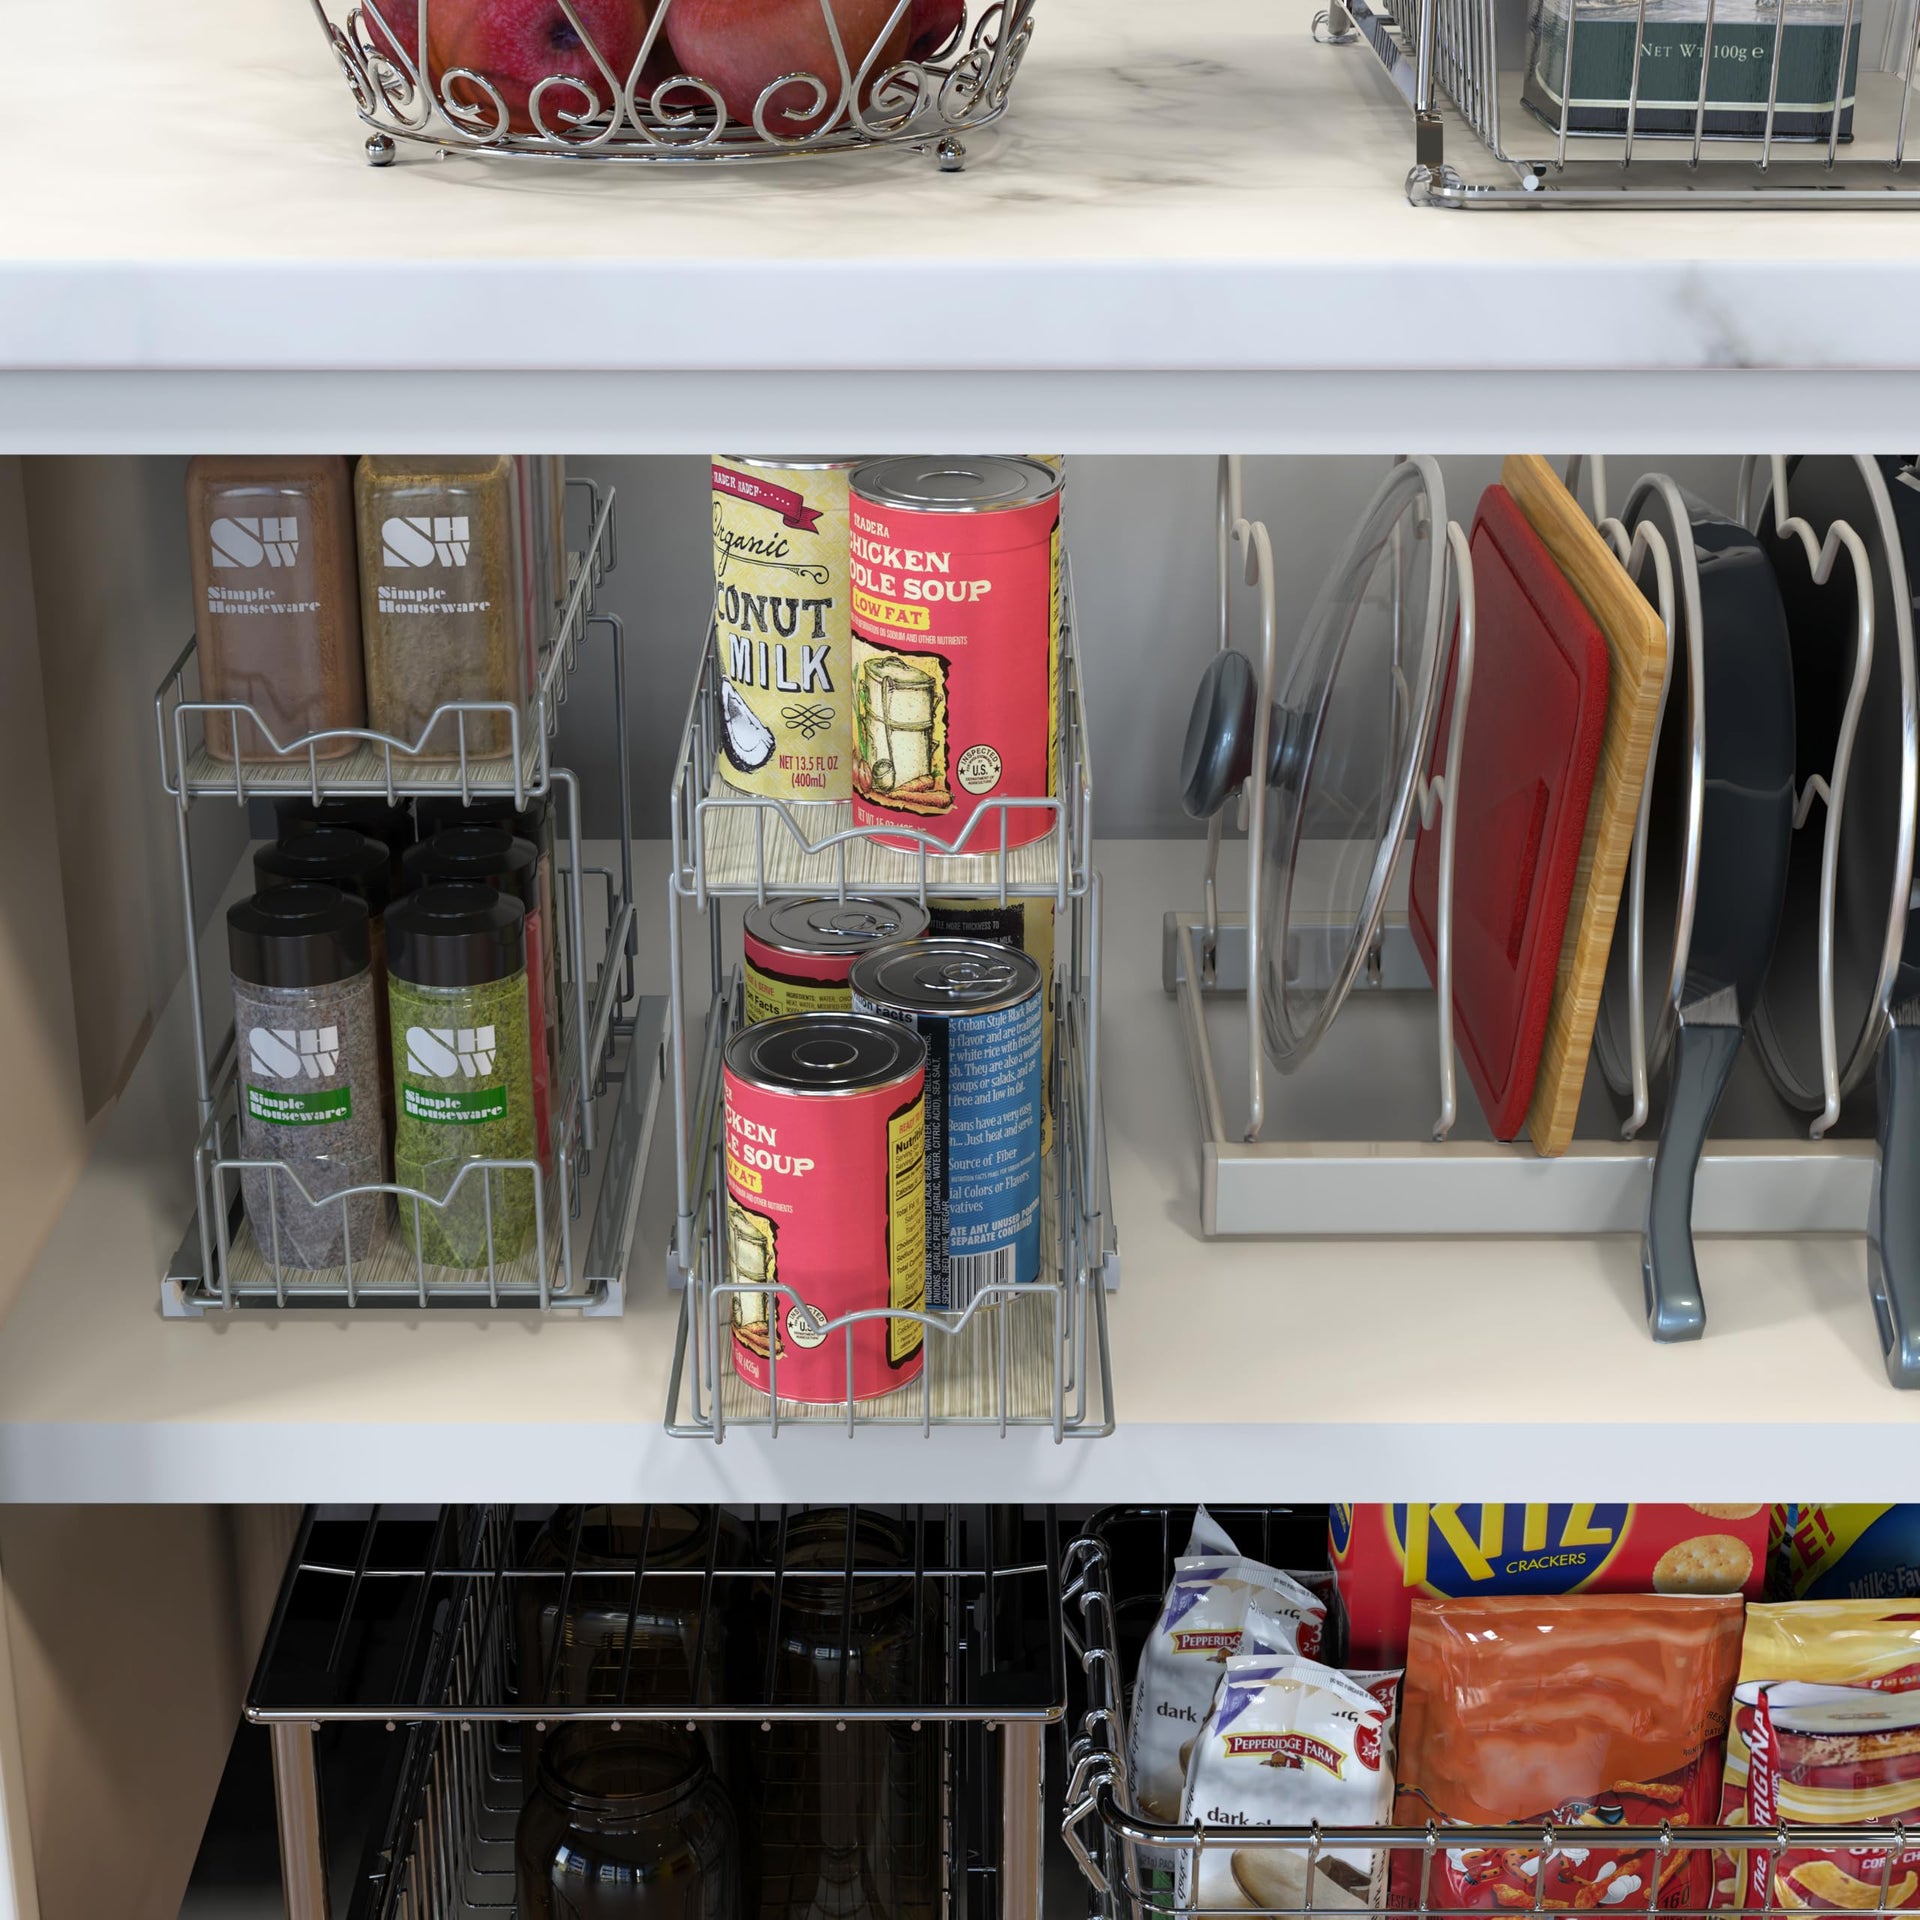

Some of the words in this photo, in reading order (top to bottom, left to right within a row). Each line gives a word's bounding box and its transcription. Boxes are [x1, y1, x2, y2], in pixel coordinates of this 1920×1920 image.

[1713, 45, 1748, 62] 100g
[712, 501, 789, 577] Organic
[207, 586, 276, 602] Simple
[377, 585, 446, 602] Simple
[903, 578, 992, 603] SOUP
[208, 600, 321, 615] Houseware
[378, 599, 491, 615] Houseware
[854, 592, 882, 618] LOW
[885, 605, 922, 625] FAT
[918, 634, 936, 645] OTHER
[729, 632, 836, 693] MILK
[779, 755, 794, 771] NET
[796, 756, 814, 772] 13.5
[816, 756, 826, 771] FL
[827, 755, 839, 771] OZ
[960, 747, 999, 765] INSPECTED
[791, 772, 827, 789] (400mL)
[972, 764, 989, 776] U.S.
[754, 994, 780, 1015] Facts
[957, 1017, 986, 1032] Cuban
[986, 1011, 1007, 1029] Style
[957, 1033, 985, 1047] flavor
[986, 1029, 1002, 1043] and
[1003, 1026, 1016, 1039] are
[957, 1048, 983, 1062] white
[984, 1046, 1000, 1059] rice
[1001, 1038, 1018, 1053] with
[965, 1062, 988, 1077] They
[989, 1060, 1004, 1073] are
[1003, 1054, 1019, 1069] also
[932, 1080, 941, 1095] SEA
[952, 1080, 979, 1093] soups
[980, 1079, 990, 1089] or
[953, 1094, 973, 1107] free
[974, 1091, 991, 1105] and
[992, 1088, 1006, 1102] low
[1007, 1085, 1015, 1098] in
[249, 1089, 305, 1110] Simple
[404, 1088, 462, 1110] Simple
[250, 1102, 348, 1121] Houseware
[405, 1101, 503, 1121] Houseware
[948, 1118, 975, 1131] Beans
[975, 1117, 997, 1130] have
[1003, 1109, 1020, 1122] very
[932, 1122, 941, 1149] CITRIC
[964, 1132, 984, 1146] Just
[985, 1130, 1003, 1143] heat
[1003, 1122, 1018, 1137] and
[743, 1143, 815, 1177] SOUP
[932, 1151, 942, 1179] WATER,
[948, 1157, 981, 1171] Source
[982, 1153, 994, 1167] of
[996, 1148, 1018, 1164] Fiber
[964, 1184, 993, 1198] Colors
[994, 1182, 1004, 1193] or
[949, 1200, 984, 1214] vatives
[932, 1215, 941, 1240] PUREE
[950, 1226, 967, 1237] ATE
[970, 1222, 990, 1236] ANY
[991, 1212, 1020, 1231] UNUSED
[951, 1231, 996, 1247] SEPARATE
[932, 1243, 941, 1271] GARLIC
[1506, 1553, 1586, 1574] CRACKERS
[1156, 1701, 1198, 1724] dark
[1234, 1737, 1302, 1752] PEPPERIDGE
[1304, 1737, 1335, 1767] FARM
[1207, 1806, 1249, 1826] dark
[1753, 1854, 1767, 1898] The
